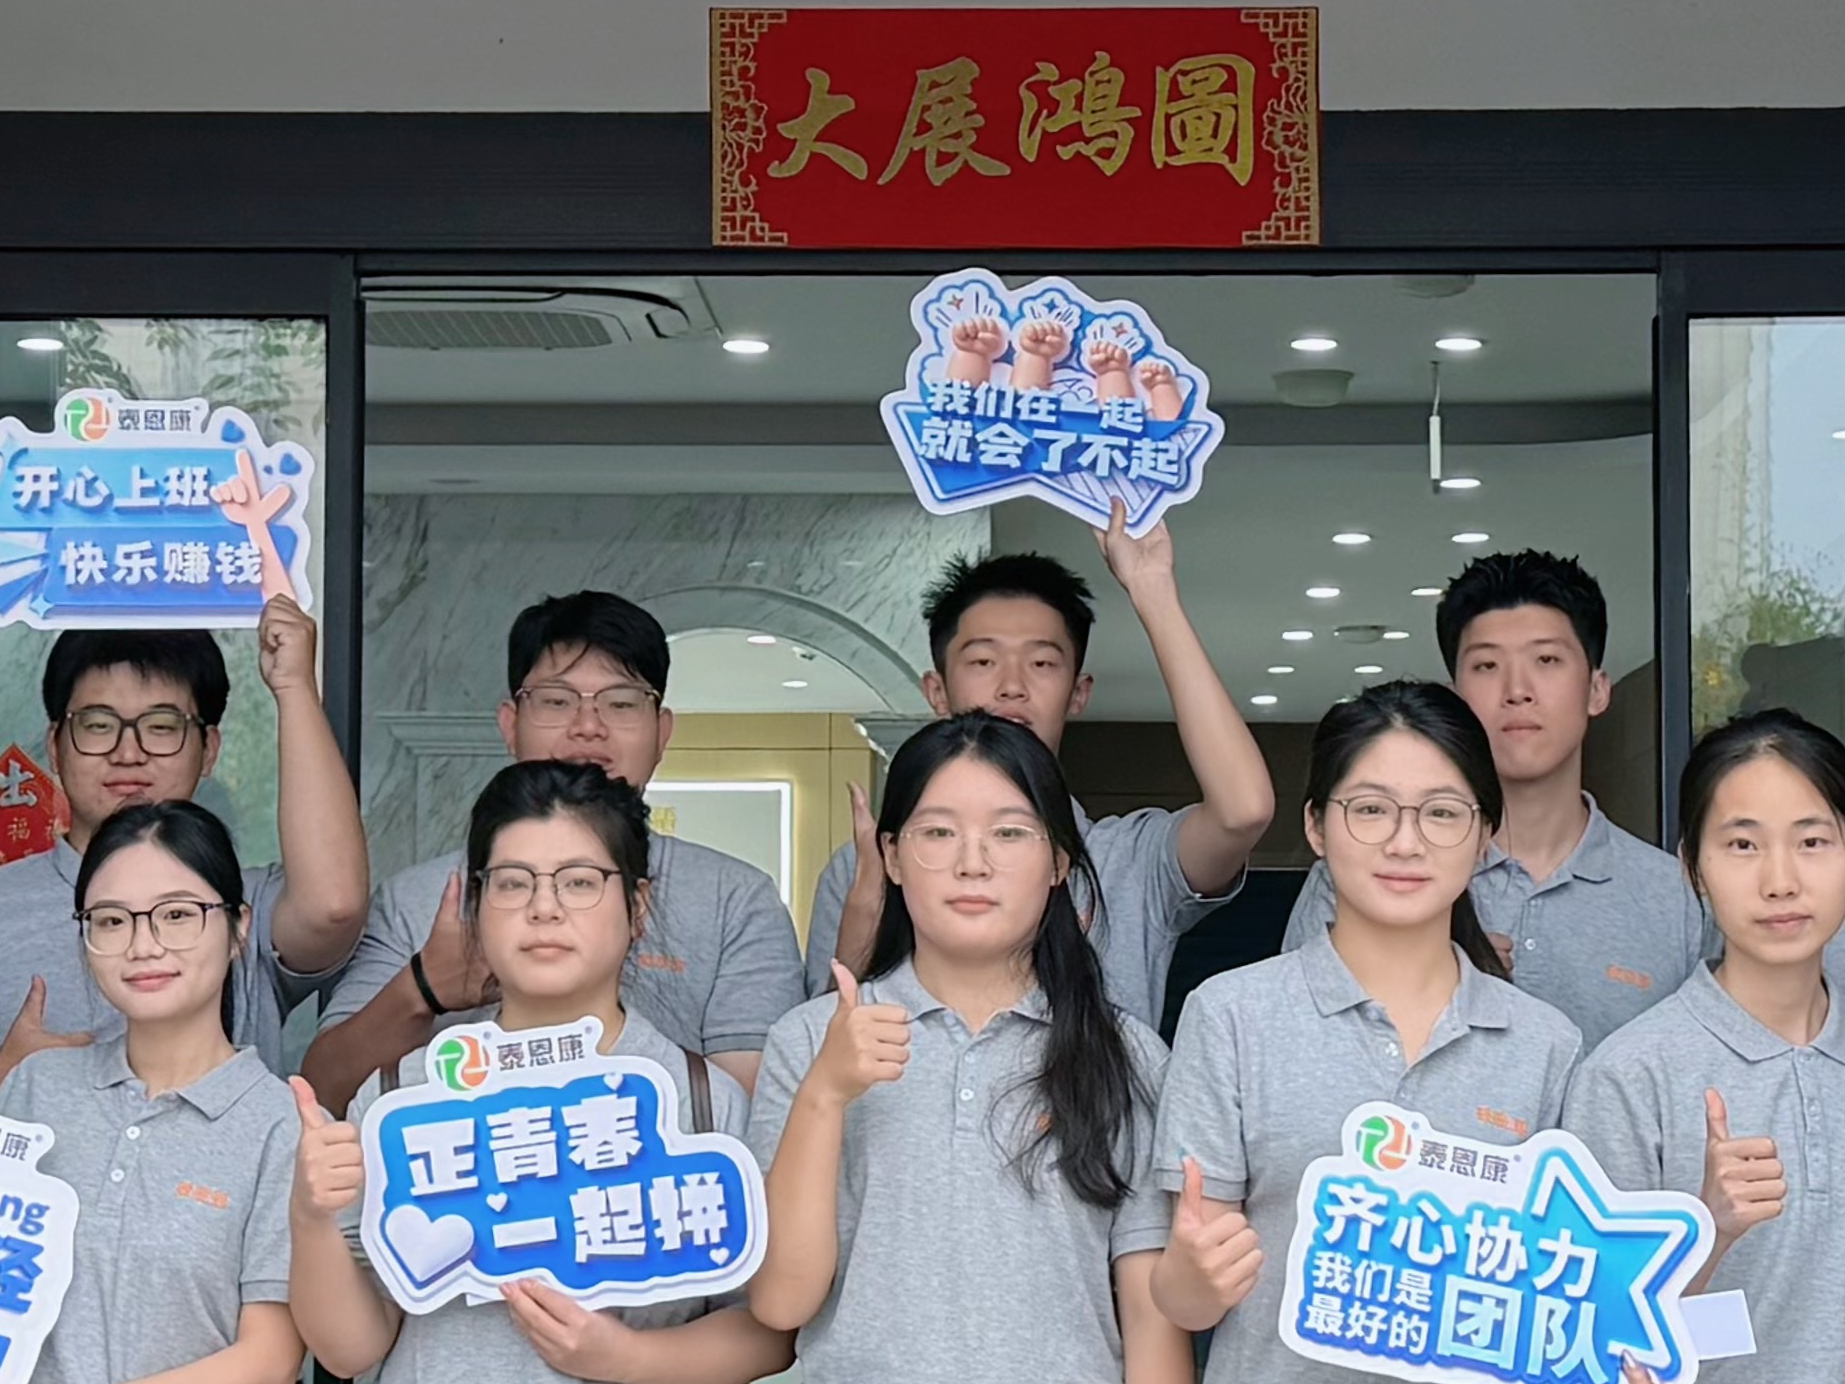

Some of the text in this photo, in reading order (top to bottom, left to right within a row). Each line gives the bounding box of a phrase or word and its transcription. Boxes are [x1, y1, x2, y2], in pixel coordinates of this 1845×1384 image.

[767, 52, 1257, 187] 大展鴻圖
[117, 408, 193, 433] 泰恩康
[925, 378, 1145, 434] 我们在一起
[917, 420, 1181, 485] 就会了不起
[12, 465, 212, 511] 开心上班
[61, 539, 264, 587] 快乐赚钱
[496, 1033, 586, 1071] 泰恩康
[401, 1093, 643, 1197] 正青春
[1417, 1139, 1510, 1185] 泰恩康
[491, 1171, 729, 1265] 一起拼
[1322, 1181, 1598, 1299] 齐心协力
[1310, 1249, 1434, 1314] 我们是
[1302, 1292, 1430, 1355] 最好的
